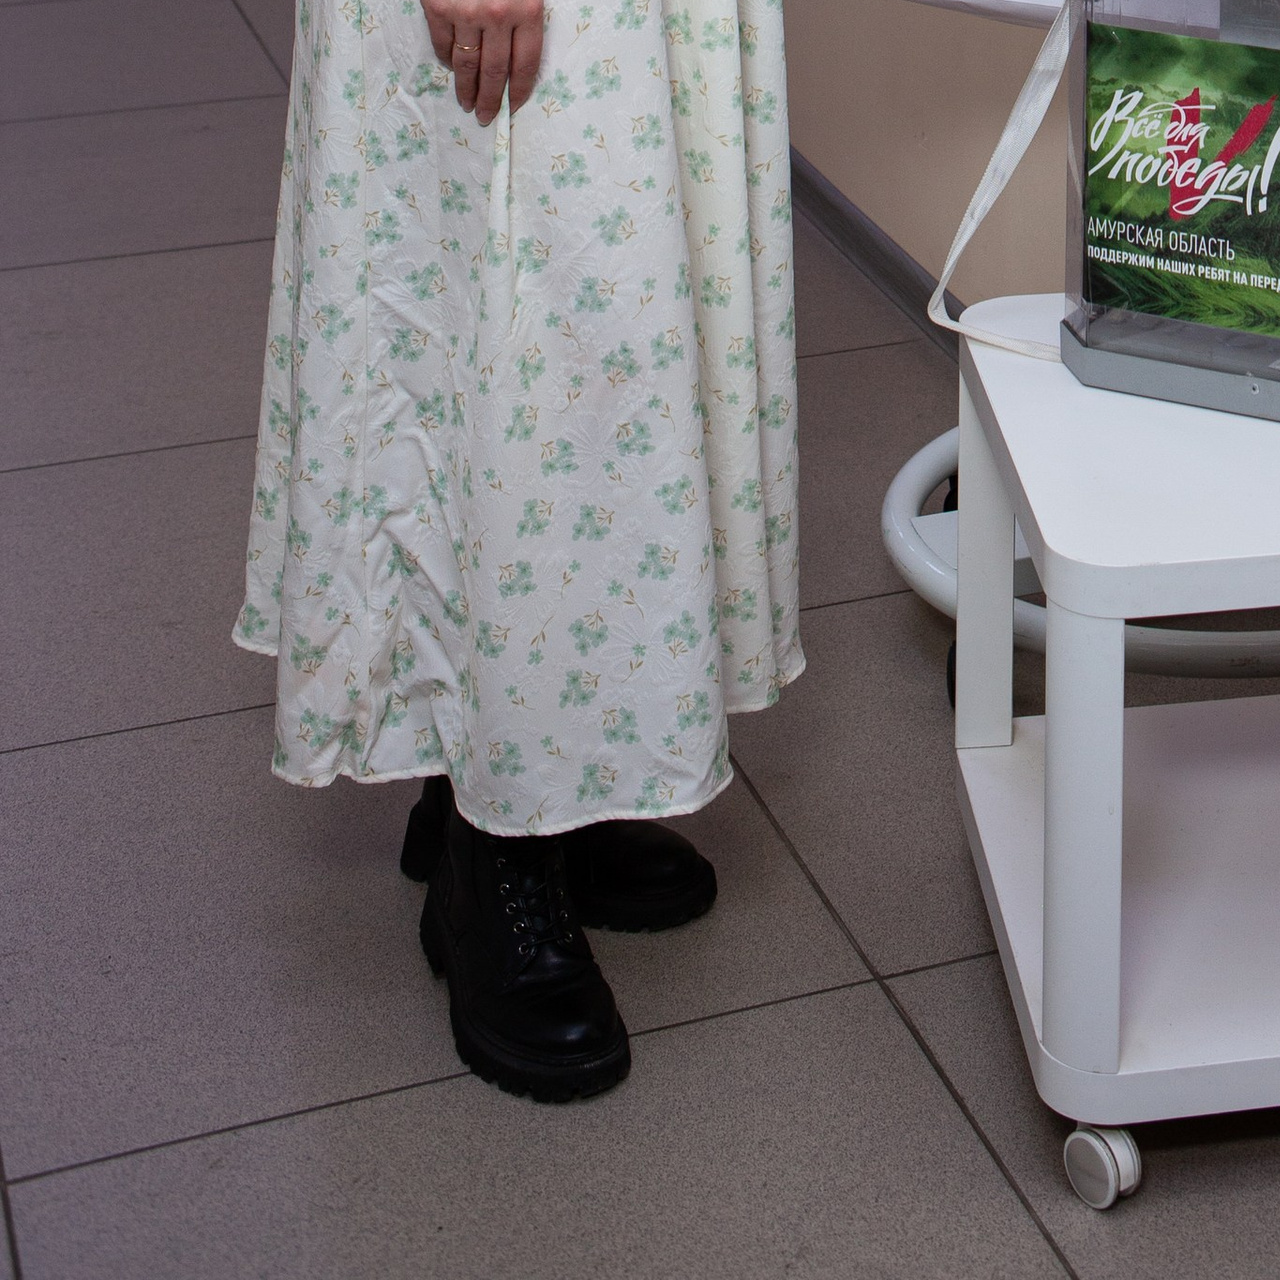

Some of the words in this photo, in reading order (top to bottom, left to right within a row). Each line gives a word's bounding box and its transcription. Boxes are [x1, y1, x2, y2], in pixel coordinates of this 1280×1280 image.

[1087, 216, 1163, 249] АМУРСКАЯ
[1169, 230, 1235, 261] ОБЛАСТЬ
[1087, 245, 1155, 269] ПОДДЕРЖИМ
[1157, 257, 1195, 277] НАШИХ
[1198, 264, 1231, 283] РЕБЯТ
[1233, 271, 1248, 286] НА
